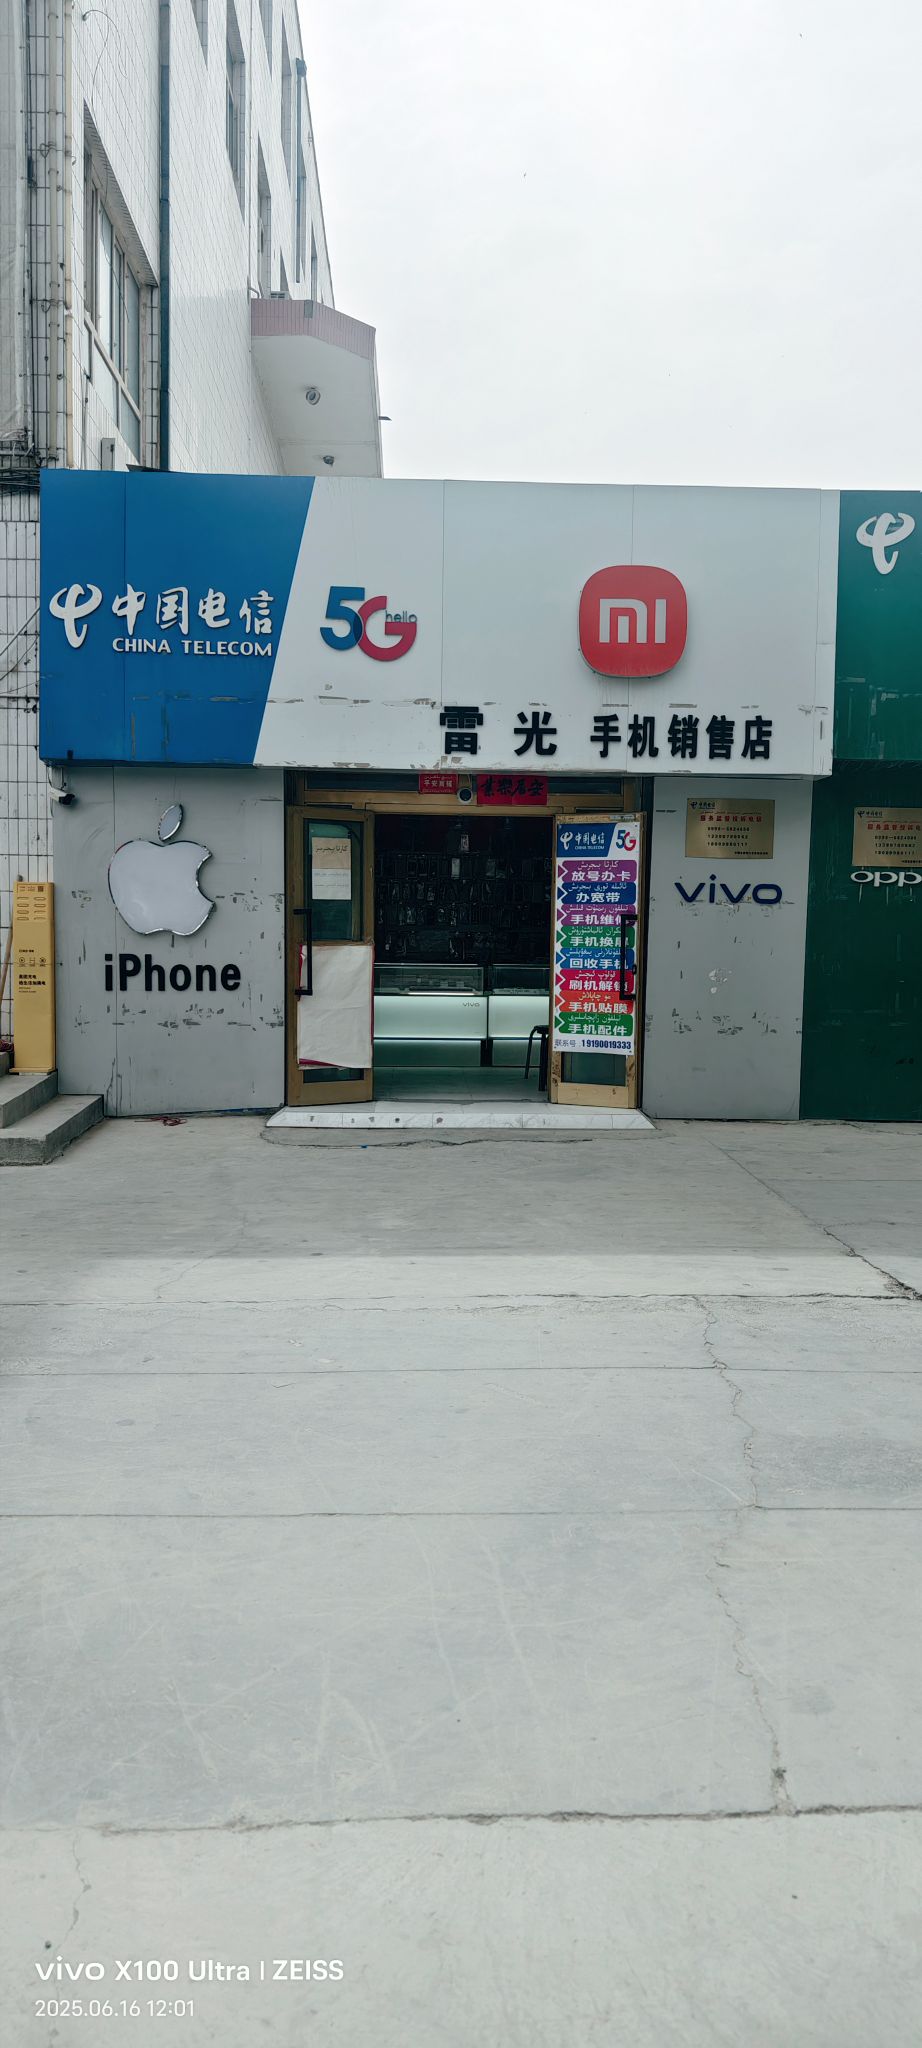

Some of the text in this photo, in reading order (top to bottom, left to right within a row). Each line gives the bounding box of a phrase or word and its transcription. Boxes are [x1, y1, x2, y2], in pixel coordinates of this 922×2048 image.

[111, 584, 274, 636] 中国电信
[385, 609, 417, 623] hello
[319, 586, 417, 662] 5G
[112, 637, 272, 657] CHINA TELECOM
[590, 714, 773, 760] 手机销售店
[575, 832, 605, 846] 中国电信
[616, 830, 637, 851] 5G
[571, 871, 631, 881] 放号办卡
[575, 892, 621, 903] 办宽带
[674, 874, 783, 905] vivo
[104, 953, 242, 992] iPhone
[568, 1002, 628, 1013] 手机贴膜
[567, 1023, 628, 1036] 手机配件
